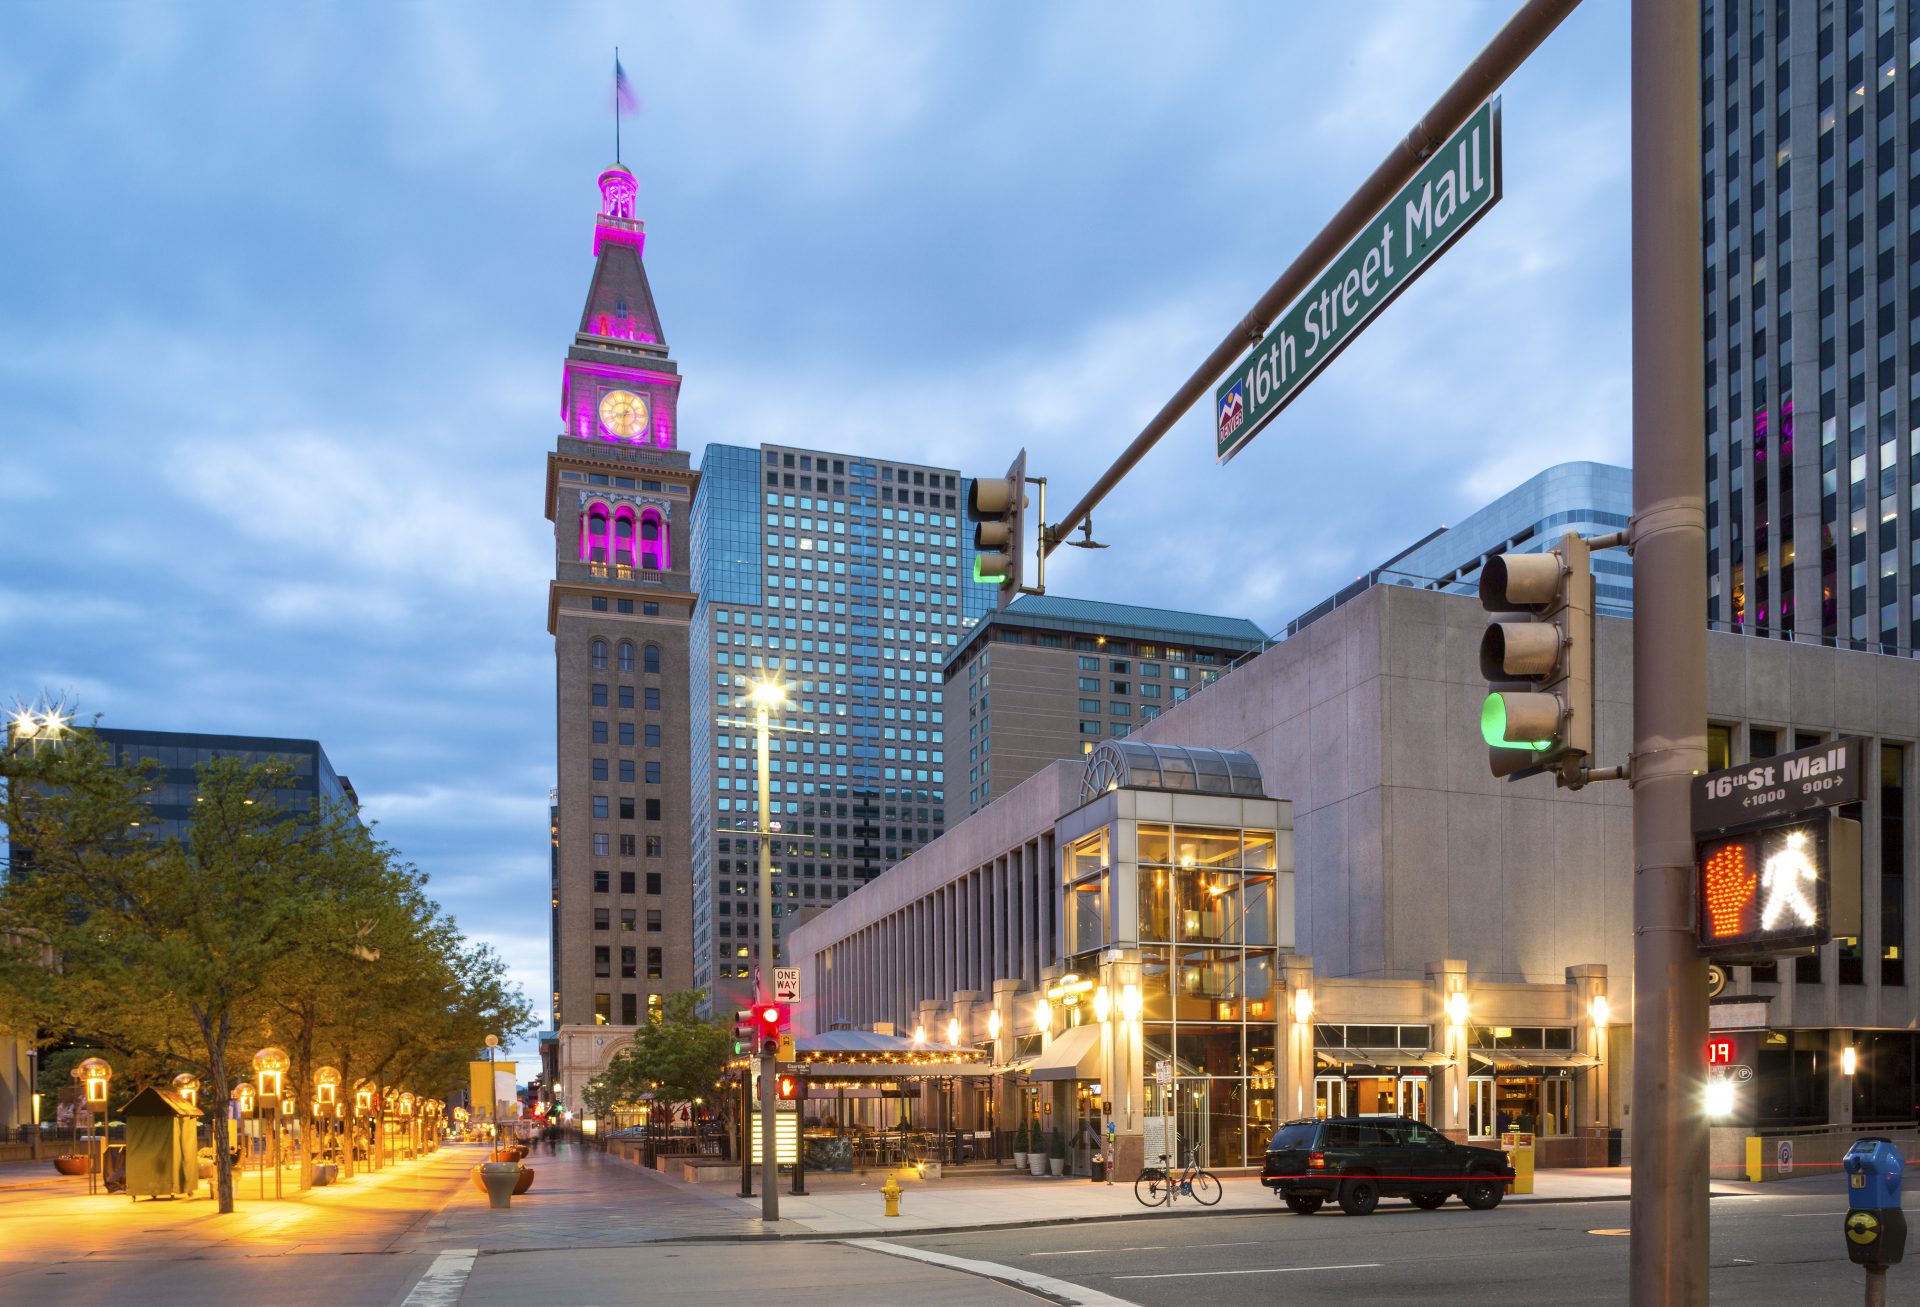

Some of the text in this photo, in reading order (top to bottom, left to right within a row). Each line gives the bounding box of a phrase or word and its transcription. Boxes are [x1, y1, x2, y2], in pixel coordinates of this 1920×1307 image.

[1244, 126, 1484, 414] 16th Street Mall
[1219, 410, 1244, 443] DENVER
[1783, 747, 1846, 783] Mall
[1751, 777, 1833, 806] 1000 900
[777, 971, 797, 979] ONE
[777, 981, 797, 989] WAY
